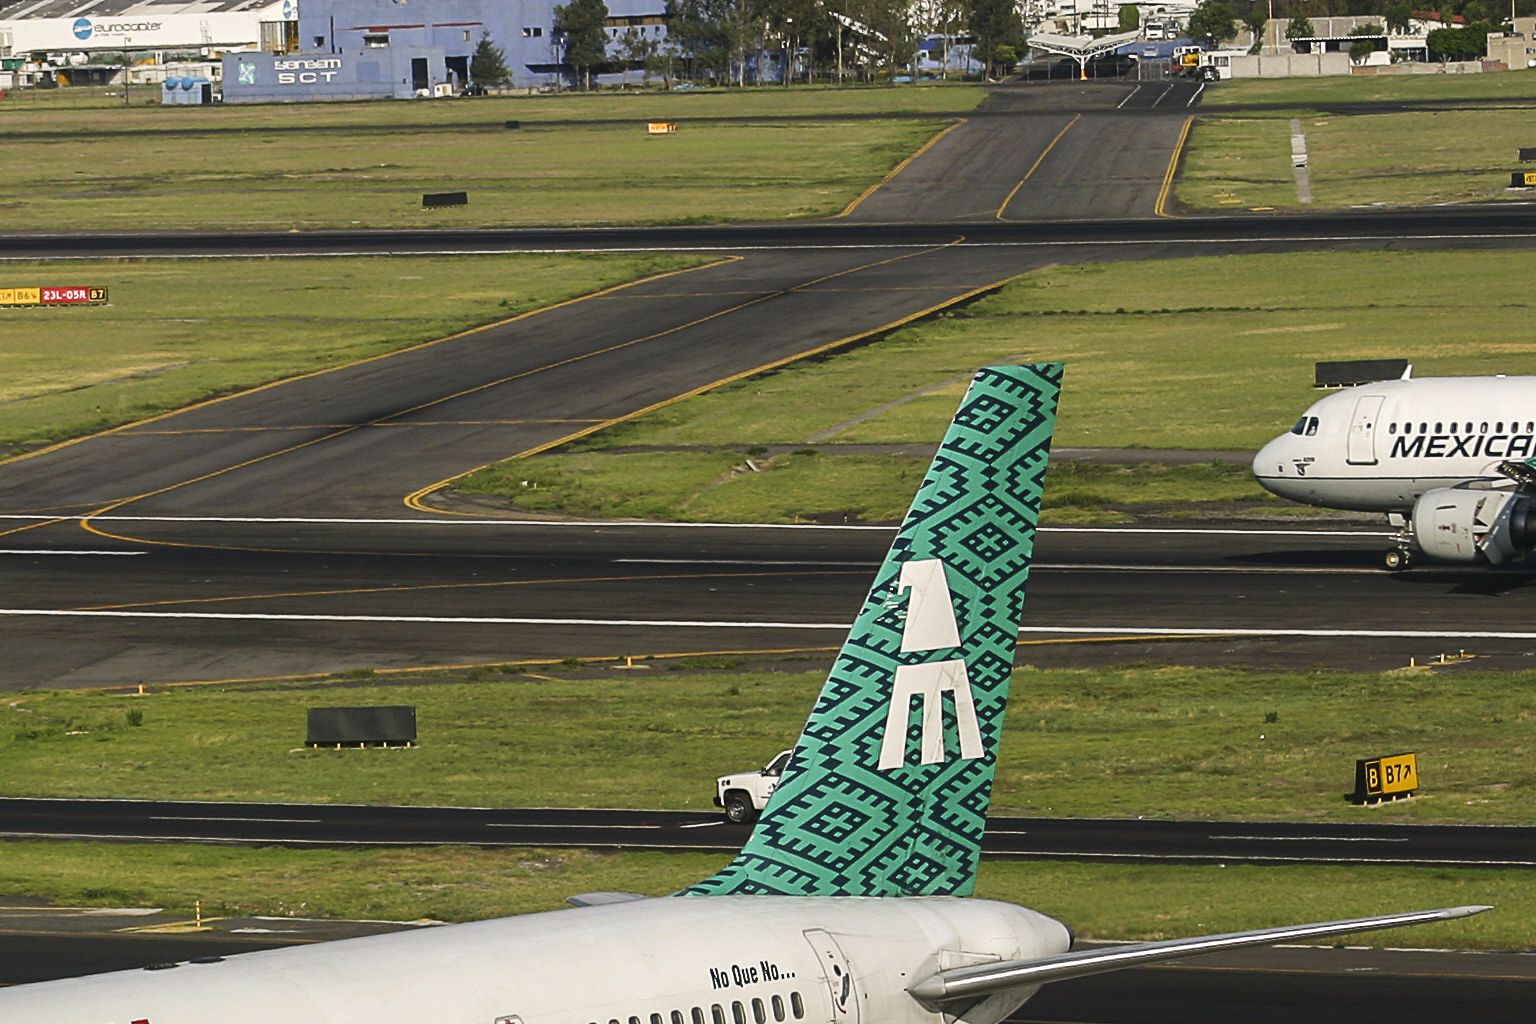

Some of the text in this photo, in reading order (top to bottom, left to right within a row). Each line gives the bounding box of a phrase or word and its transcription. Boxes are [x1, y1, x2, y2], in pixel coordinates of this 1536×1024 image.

[278, 71, 337, 84] SCT
[43, 290, 86, 300] 23L-05R
[91, 290, 104, 299] B7
[1390, 434, 1536, 458] MEXICA
[1369, 764, 1402, 788] B B7
[709, 960, 796, 990] No Que No...
